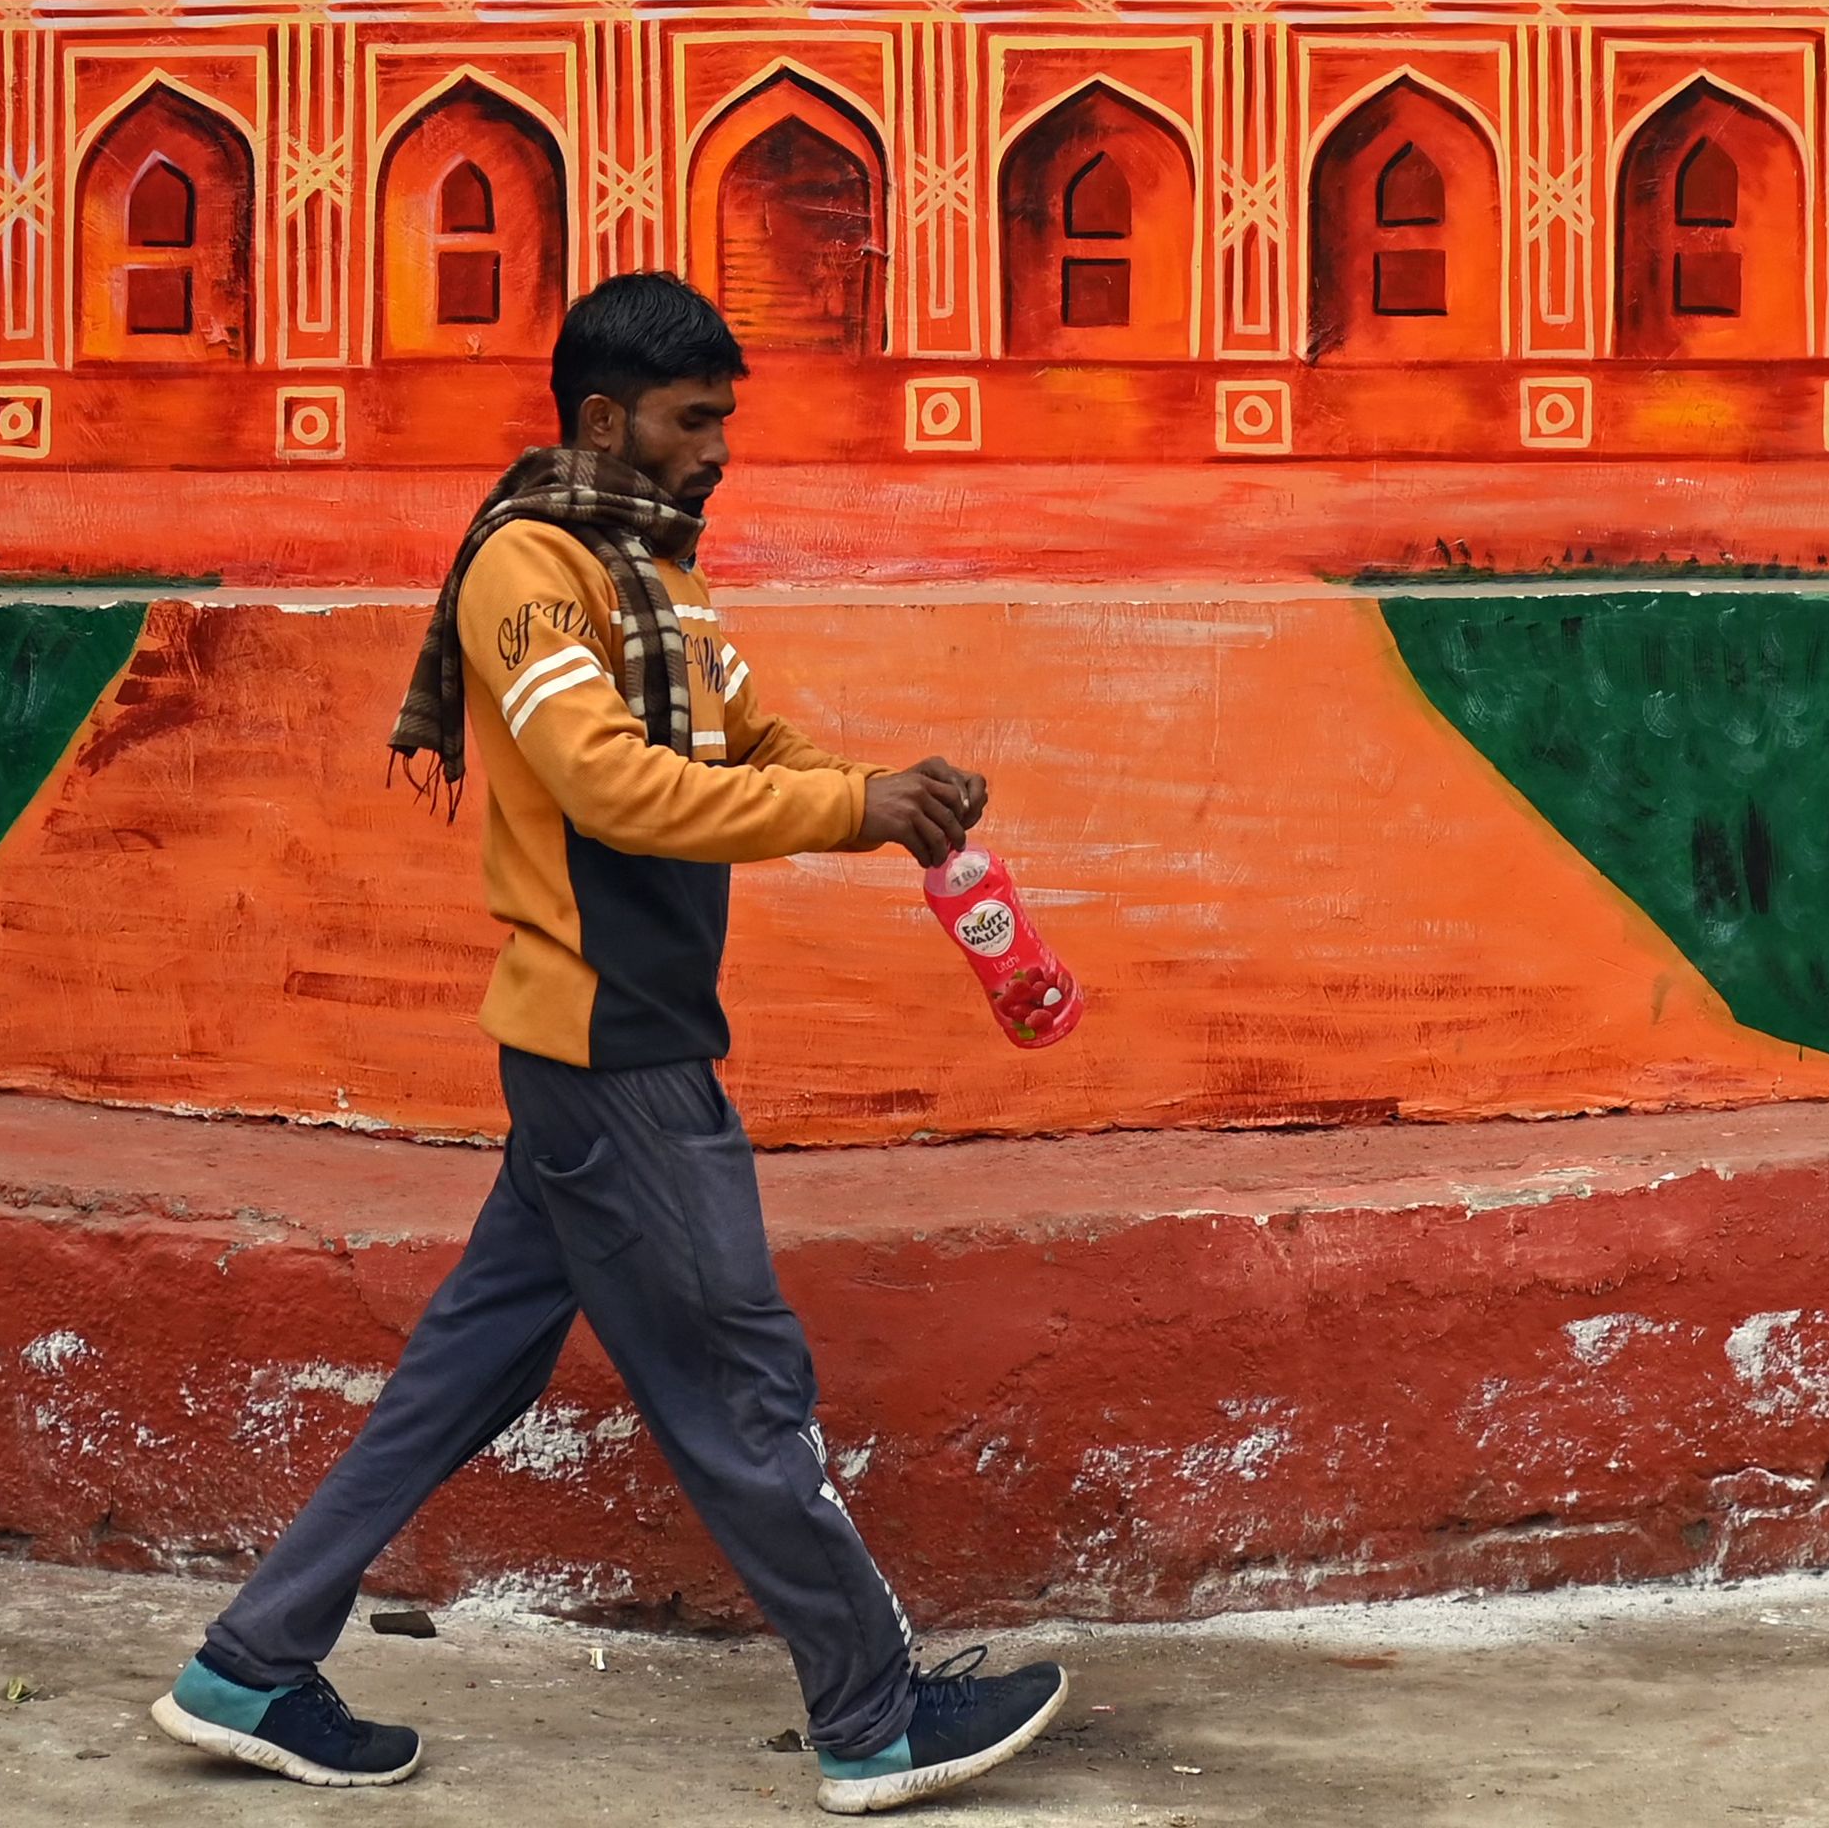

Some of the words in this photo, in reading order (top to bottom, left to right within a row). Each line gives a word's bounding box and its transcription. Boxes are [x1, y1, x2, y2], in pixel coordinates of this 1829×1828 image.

[497, 599, 541, 671] Off
[961, 909, 1004, 938] FRUIT
[963, 915, 1010, 947] VALLEY
[993, 954, 1020, 975] Litchi
